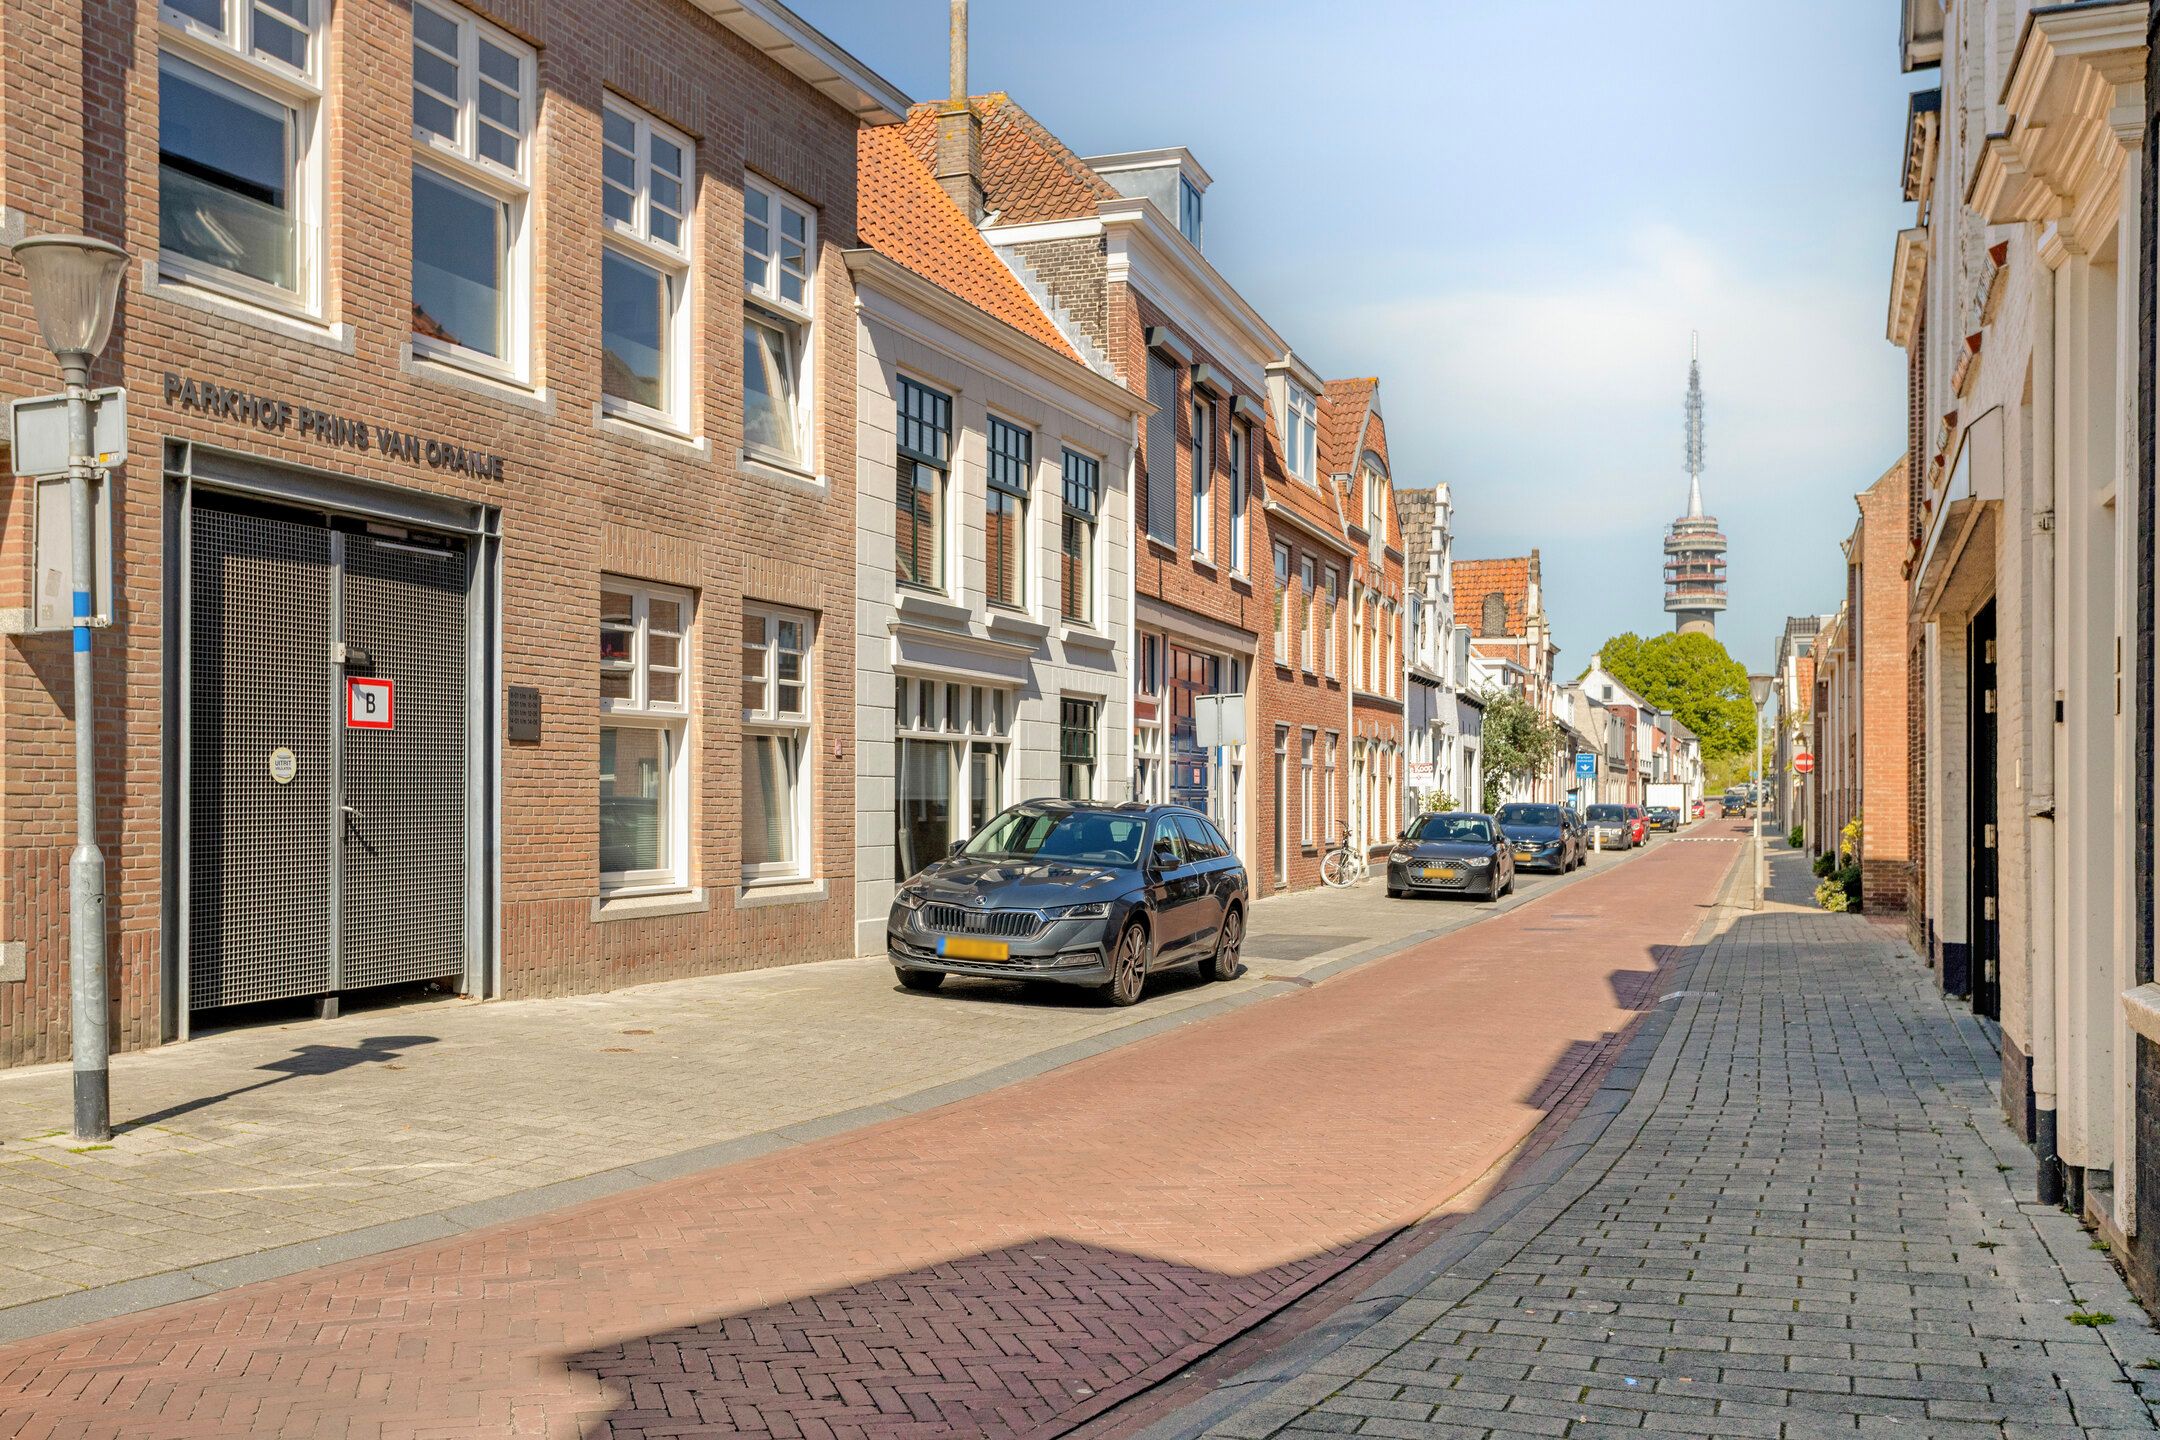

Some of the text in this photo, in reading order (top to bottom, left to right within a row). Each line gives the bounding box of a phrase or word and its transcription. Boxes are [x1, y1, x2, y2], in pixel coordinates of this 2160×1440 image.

[164, 371, 504, 481] PARKHOF PRINS VAN ORANJE
[366, 692, 376, 714] B
[1416, 764, 1433, 774] Koop
